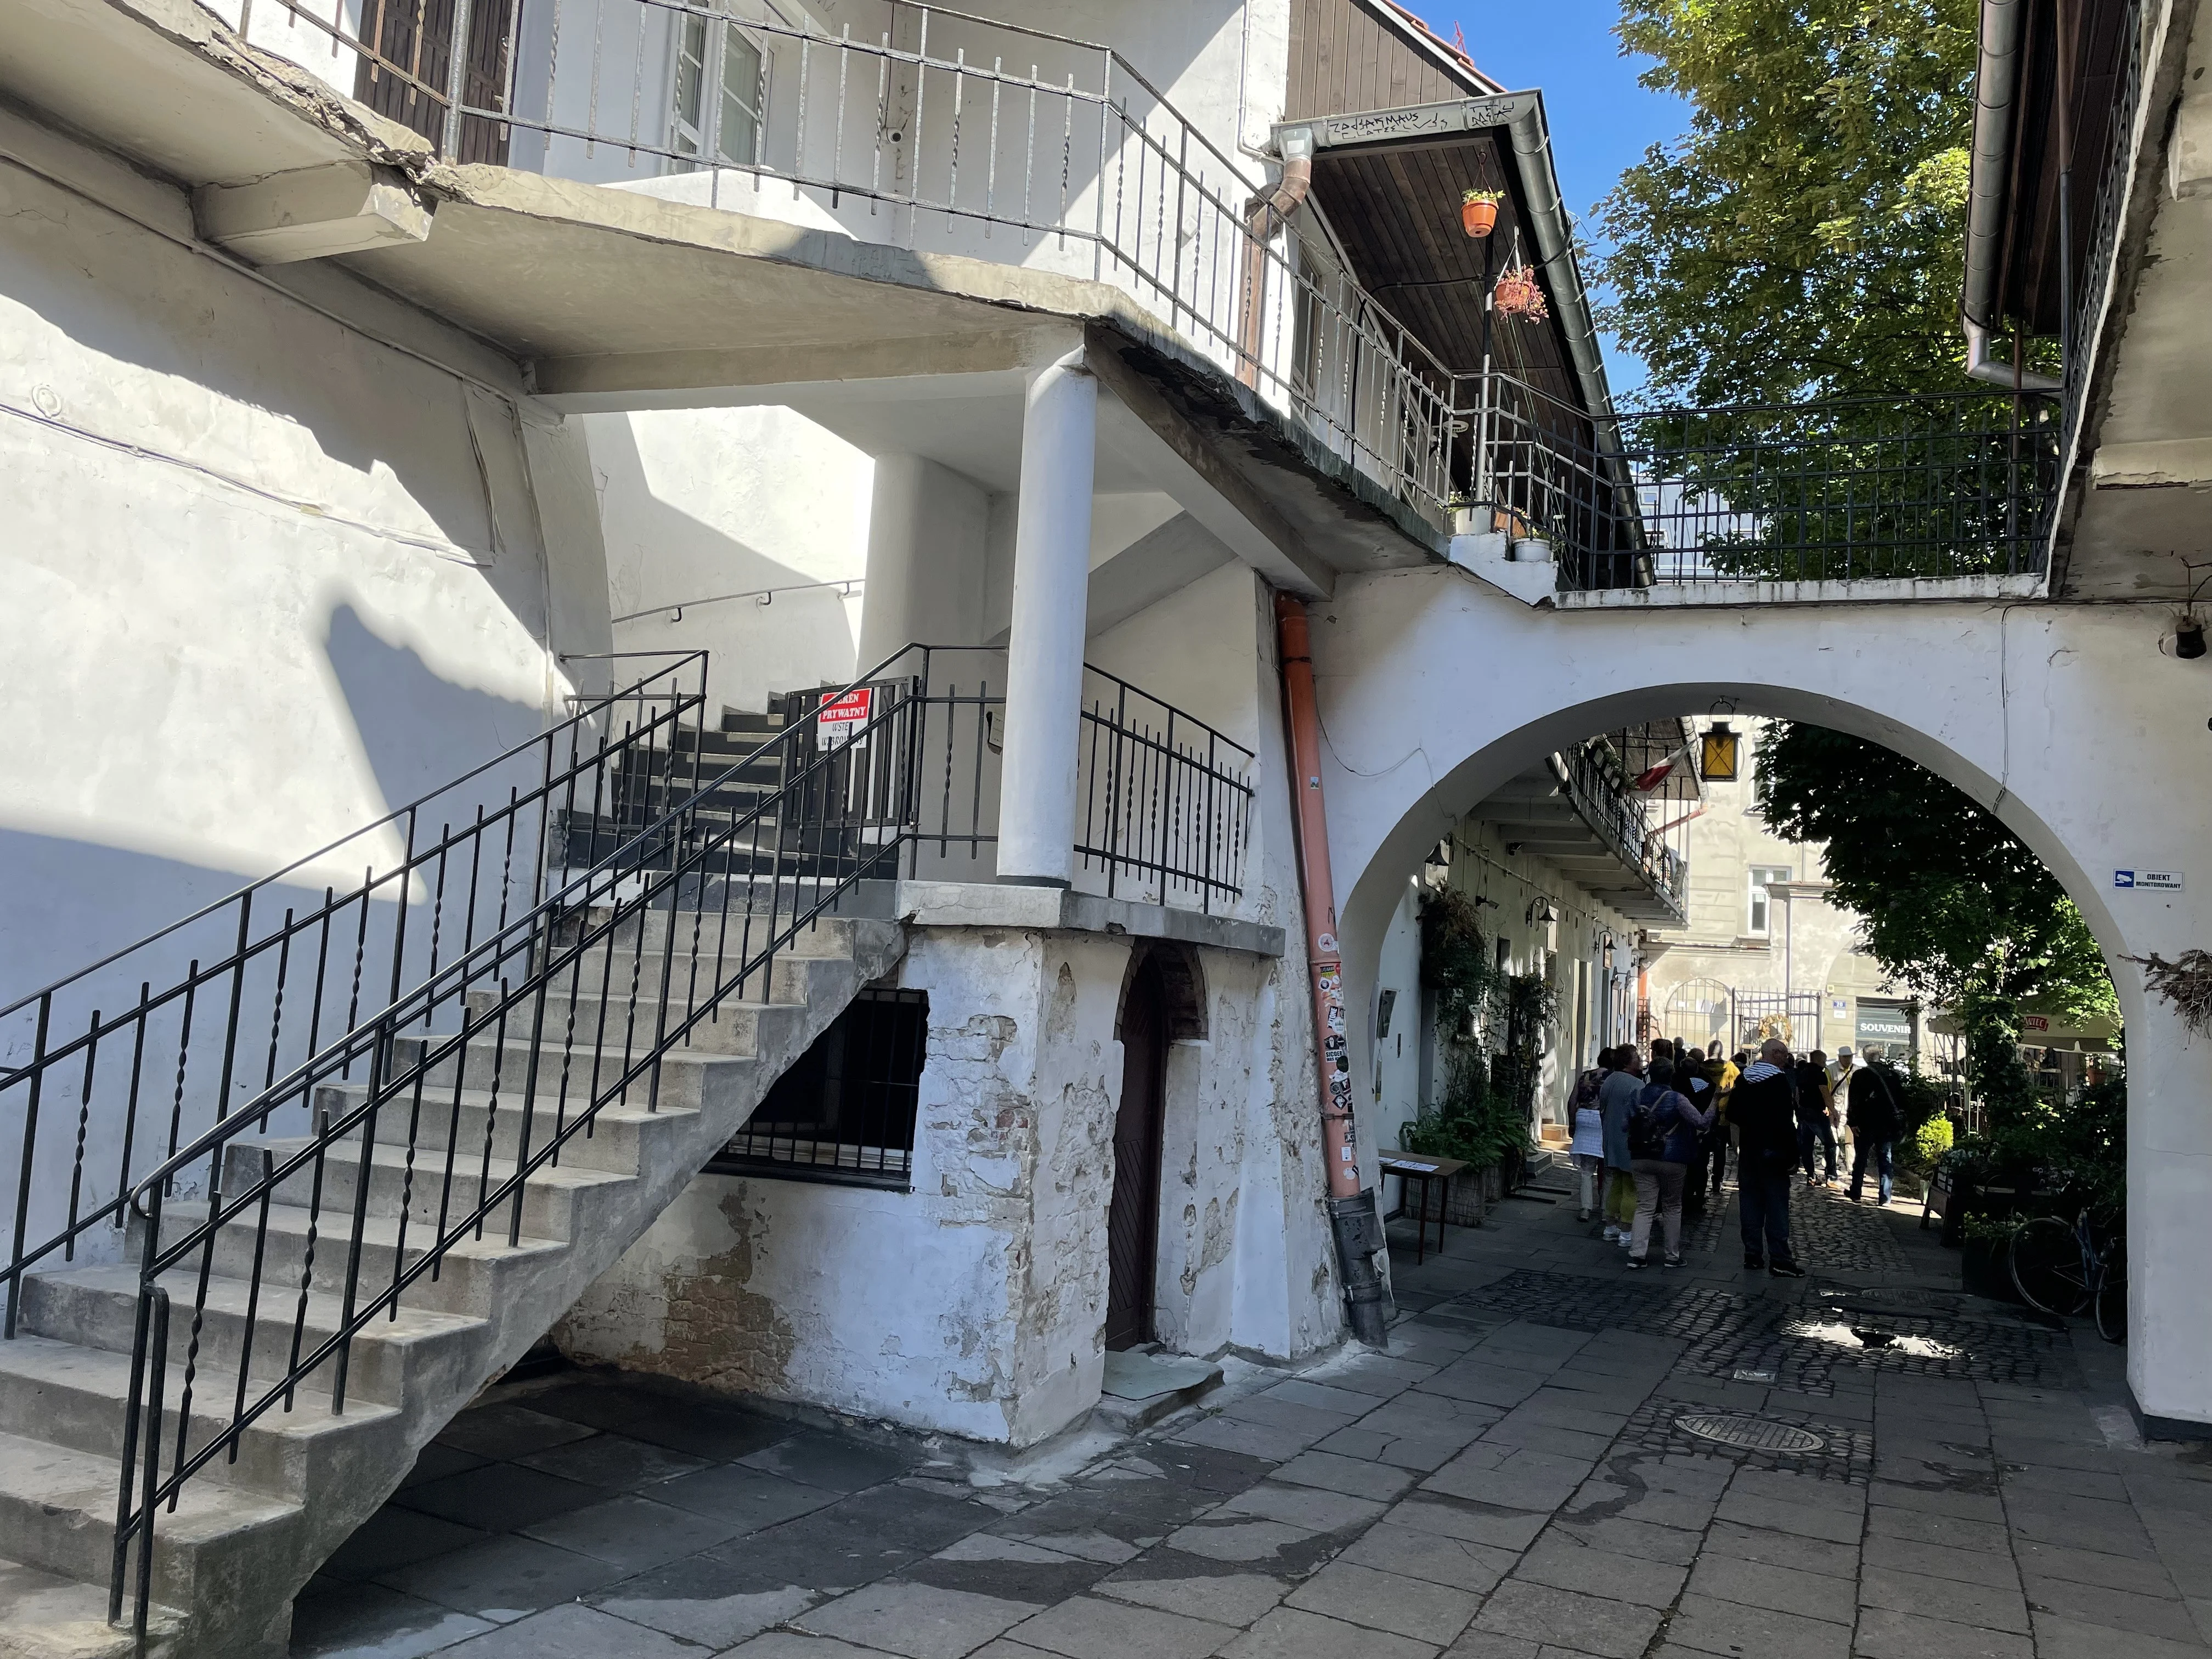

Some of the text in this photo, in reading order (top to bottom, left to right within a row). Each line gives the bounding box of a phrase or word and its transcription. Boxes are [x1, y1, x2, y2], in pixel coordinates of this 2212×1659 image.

[833, 693, 860, 704] EREN
[822, 706, 866, 720] PRYWATNY
[832, 721, 850, 733] WSTĘ
[1860, 1023, 1911, 1034] SOUVENIR
